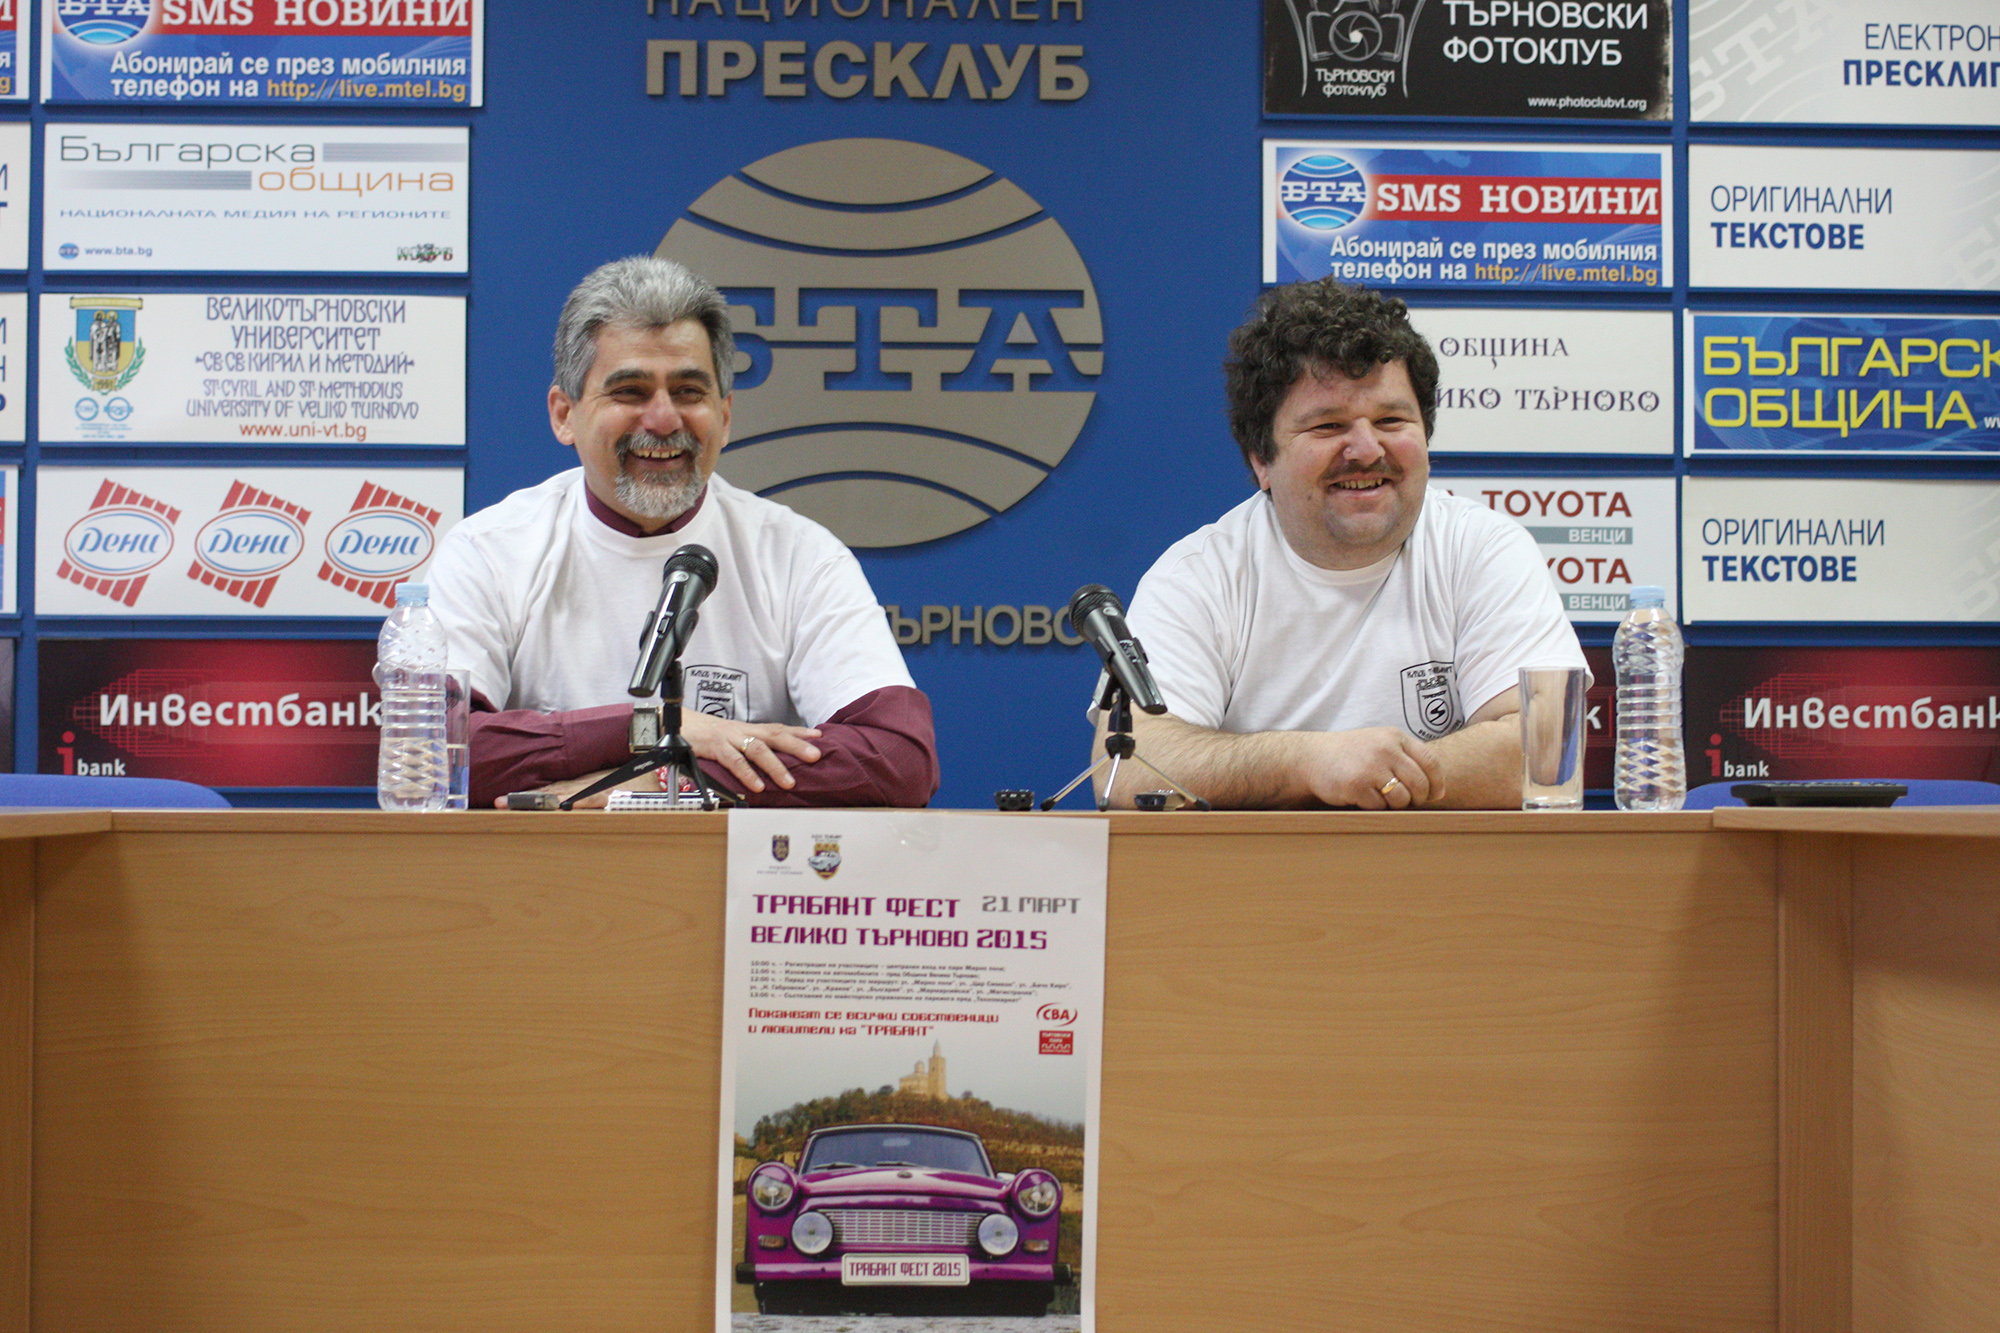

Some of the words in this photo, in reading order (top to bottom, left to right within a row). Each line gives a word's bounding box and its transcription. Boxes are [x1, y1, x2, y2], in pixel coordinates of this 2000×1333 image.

[162, 0, 254, 27] SMS
[273, 0, 469, 27] НОВИНИ
[1443, 0, 1648, 30] ТЪРНОВСКИ
[110, 50, 233, 76] Абонирай
[240, 55, 270, 75] се
[276, 57, 336, 80] през
[342, 54, 467, 77] мобилния
[1442, 36, 1622, 67] ФОТОКЛУБ
[646, 39, 1090, 101] ПРЕСКЛУБ
[1314, 67, 1395, 85] ТЪРНОВСКИ
[111, 78, 222, 99] телефон
[229, 80, 259, 98] на
[266, 78, 467, 102] http://live.mtel.bg
[1527, 95, 1648, 113] www.photoclubvt.org
[59, 135, 316, 169] Българска
[258, 166, 455, 198] община
[1281, 180, 1367, 204] БТА
[1377, 183, 1461, 214] SMS
[1480, 184, 1659, 216] НОВИНИ
[1710, 185, 1893, 214] ОРИГИНАЛНИ
[60, 208, 217, 219] НАЦИОНАЛНАТА
[224, 209, 297, 219] МЕДИЯ
[303, 210, 332, 219] НА
[338, 210, 452, 220] РЕГИОНИТЕ
[1330, 235, 1443, 260] Абонирай
[1449, 240, 1477, 259] се
[1483, 240, 1537, 264] през
[1543, 241, 1658, 263] мобилния
[1710, 222, 1865, 250] ТЕКСТОВЕ
[84, 244, 153, 258] www.bta.bg
[1331, 260, 1433, 285] телефон
[1439, 264, 1467, 282] на
[1474, 263, 1658, 287] http://live.mtel.bg
[206, 296, 407, 324] ВЕЛИКОТЪРНОВСКИ
[231, 325, 382, 350] УНИВЕРСИТЕТ
[249, 353, 305, 373] КИРИЛ
[309, 353, 321, 373] И
[1439, 336, 1569, 370] ОБЩИНА
[265, 380, 295, 398] AND
[319, 380, 404, 400] METHODIUS
[1436, 387, 1502, 410] ИКО
[1515, 386, 1660, 413] ТЪРНОВО
[186, 399, 271, 418] UNIVERSITY
[274, 400, 294, 418] OF
[298, 400, 348, 419] VELIKO
[350, 400, 419, 420] TURNOVO
[1704, 387, 1977, 438] ОБЩИНА
[239, 421, 367, 442] www.uni-vt.bg
[1481, 489, 1633, 518] TOYOTA
[77, 526, 159, 554] Дени
[207, 527, 290, 555] Дени
[337, 528, 420, 556] Дени
[1568, 528, 1627, 544] ВЕНЦИ
[1702, 517, 1885, 547] ОРИГИНАЛНИ
[1547, 557, 1633, 585] OTA
[1702, 555, 1857, 583] ТЕКСТОВЕ
[1568, 595, 1627, 611] ВЕНЦИ
[99, 692, 382, 727] Инвестбанк
[77, 758, 126, 778] bank
[1723, 760, 1770, 778] bank
[752, 894, 877, 916] ТРАБАНТ
[886, 897, 961, 918] ФЕСТ
[982, 895, 1012, 913] 21
[1018, 896, 1081, 914] МАРТ
[751, 925, 847, 945] ВЕЛИКО
[856, 927, 968, 948] ТЪРНОВО
[976, 928, 1047, 950] 2015
[748, 1007, 821, 1020] Поканват
[825, 1011, 842, 1020] се
[846, 1011, 898, 1021] всички
[901, 1012, 1000, 1024] собственици
[748, 1024, 757, 1034] и
[761, 1024, 835, 1035] любители
[839, 1026, 857, 1035] на
[861, 1024, 934, 1036] "ТРАБАНТ"
[849, 1262, 897, 1277] ТРАБАНТ
[900, 1262, 929, 1277] ФЕСТ
[933, 1262, 961, 1277] 2015
